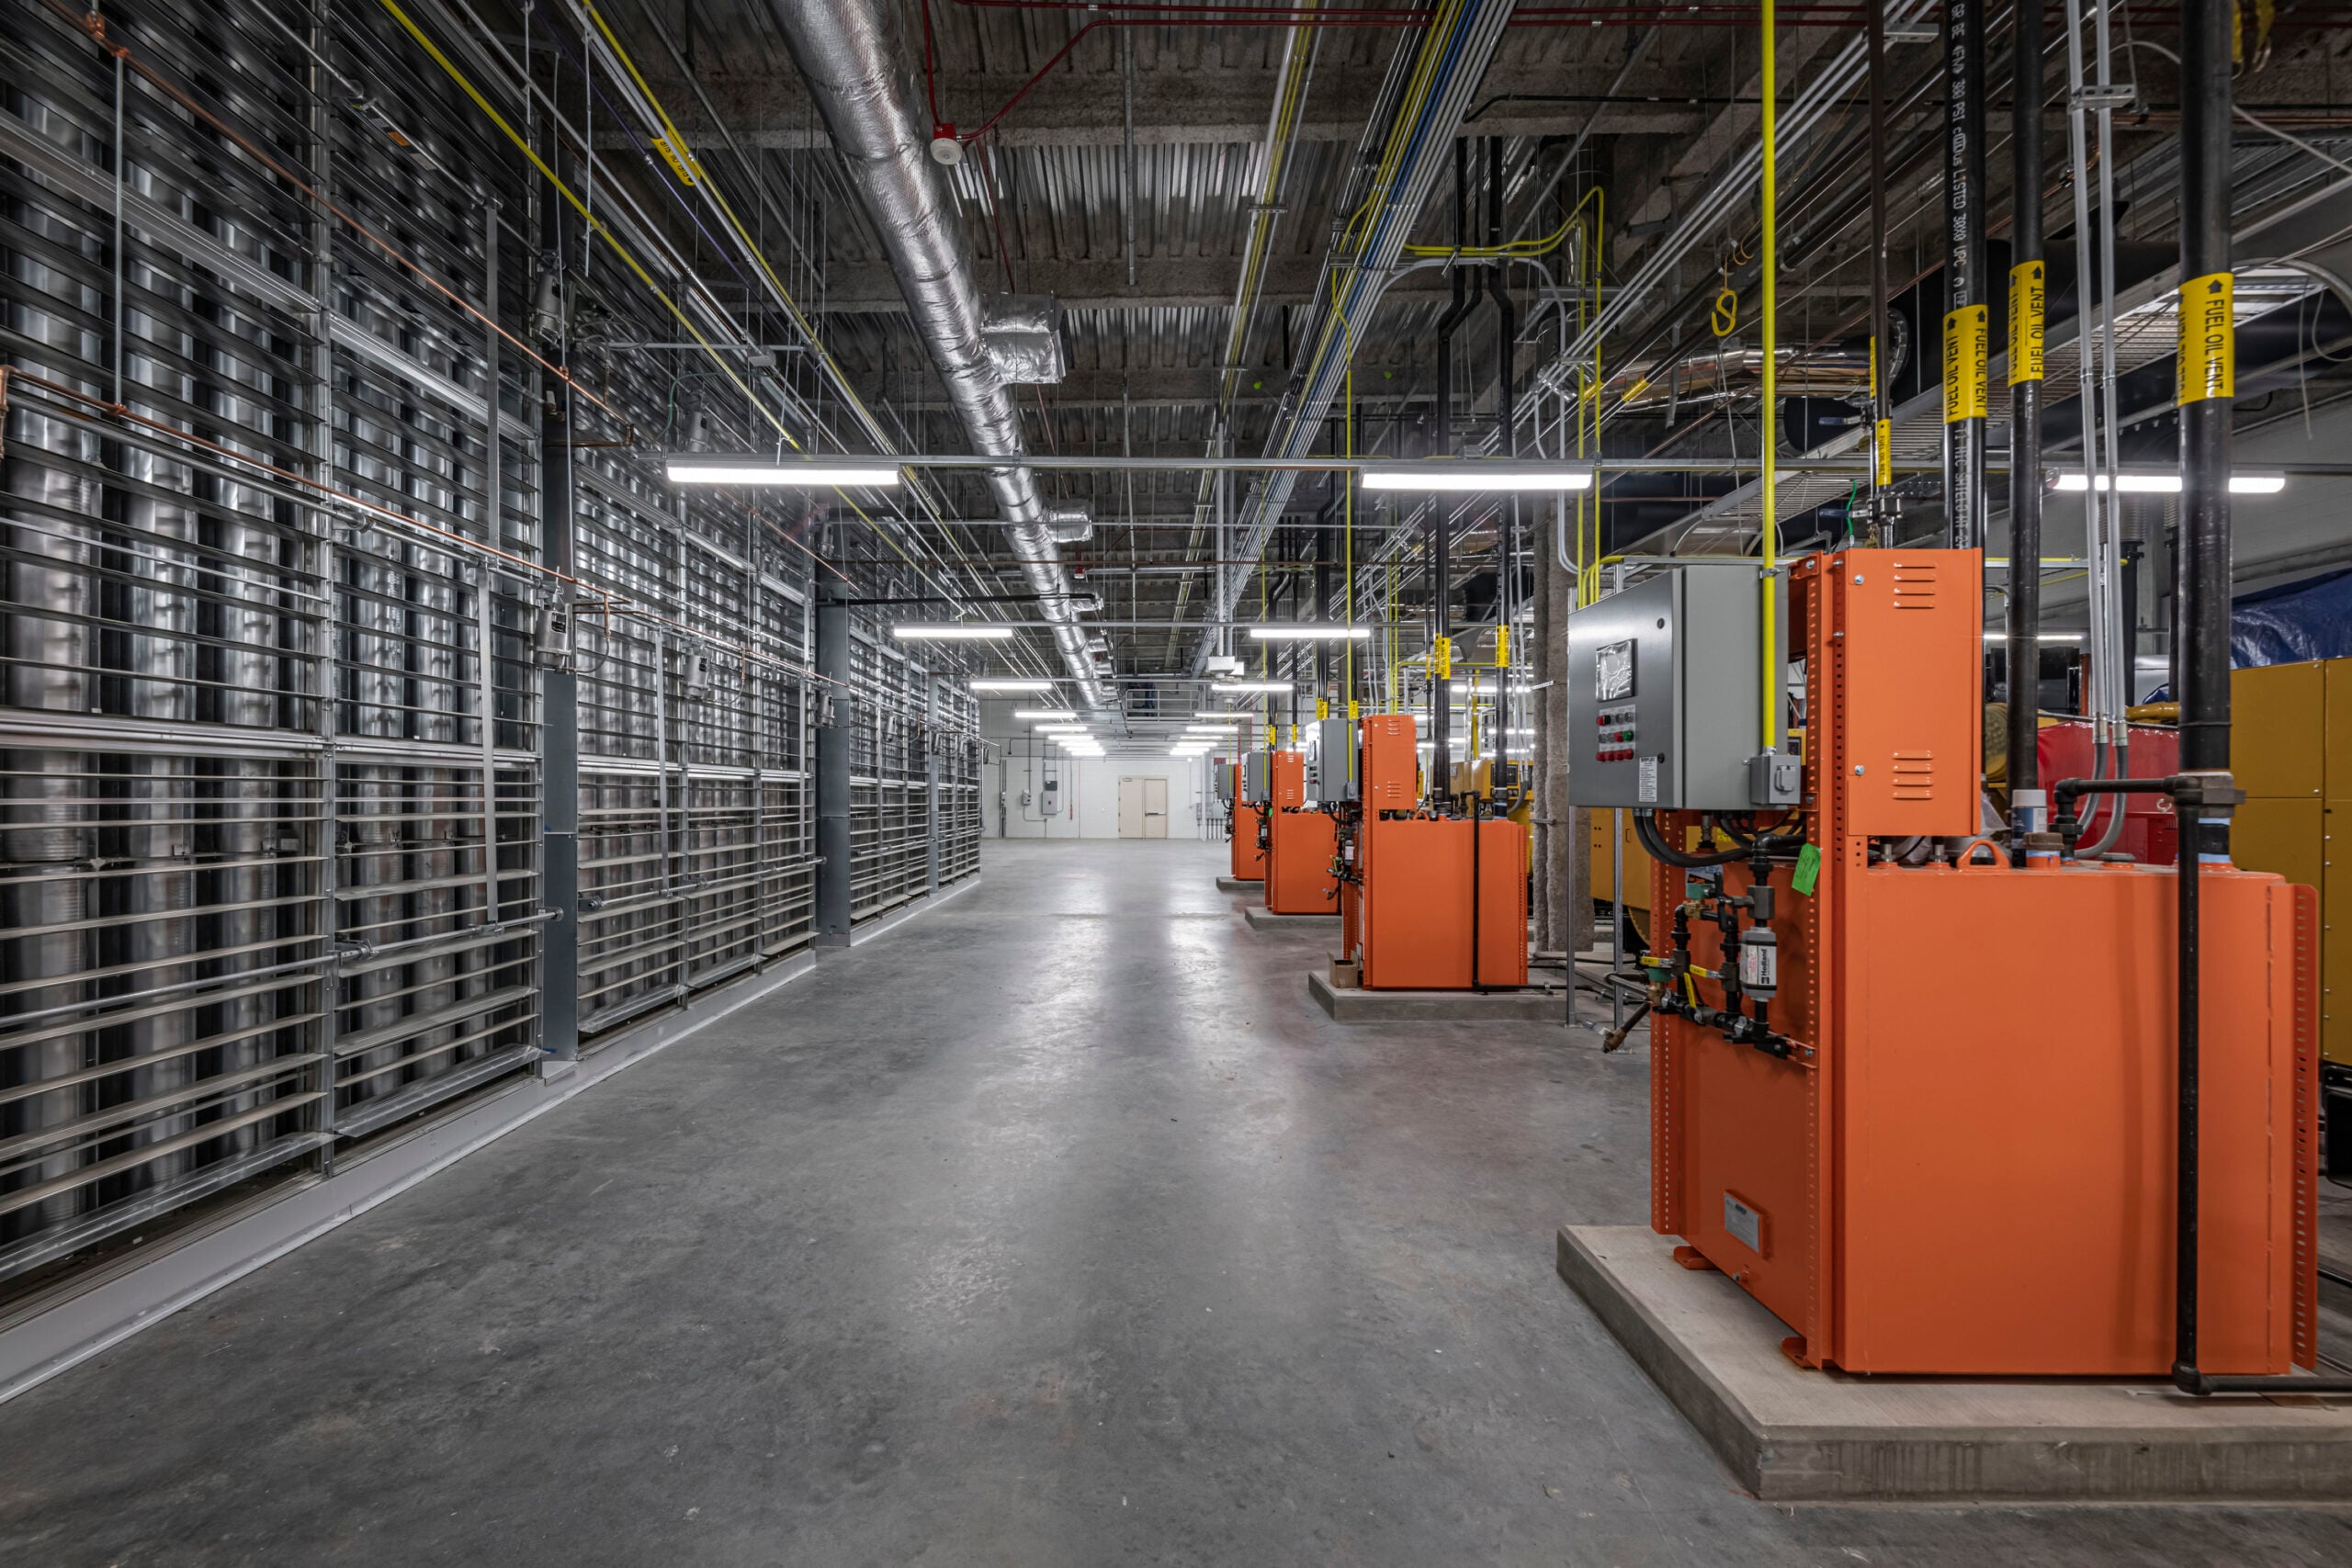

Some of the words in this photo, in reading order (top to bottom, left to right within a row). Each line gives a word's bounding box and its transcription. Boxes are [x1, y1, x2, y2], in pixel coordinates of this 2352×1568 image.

[1952, 101, 1965, 122] PSI
[1953, 168, 1967, 210] LISTED
[1953, 245, 1967, 267] UPC
[2030, 286, 2043, 318] VENT
[2205, 299, 2224, 333] FUEL
[1975, 328, 1986, 357] FUEL
[2030, 323, 2043, 339] OIL
[2205, 333, 2224, 356] OIL
[1947, 335, 1959, 366] VENT
[2030, 345, 2043, 373] FUEL
[1947, 366, 1959, 384] OIL
[1975, 359, 1986, 378] OIL
[2205, 356, 2224, 389] VENT
[1947, 386, 1959, 416] FUEL
[1975, 381, 1986, 410] VENT
[1760, 948, 1769, 976] Hedland
